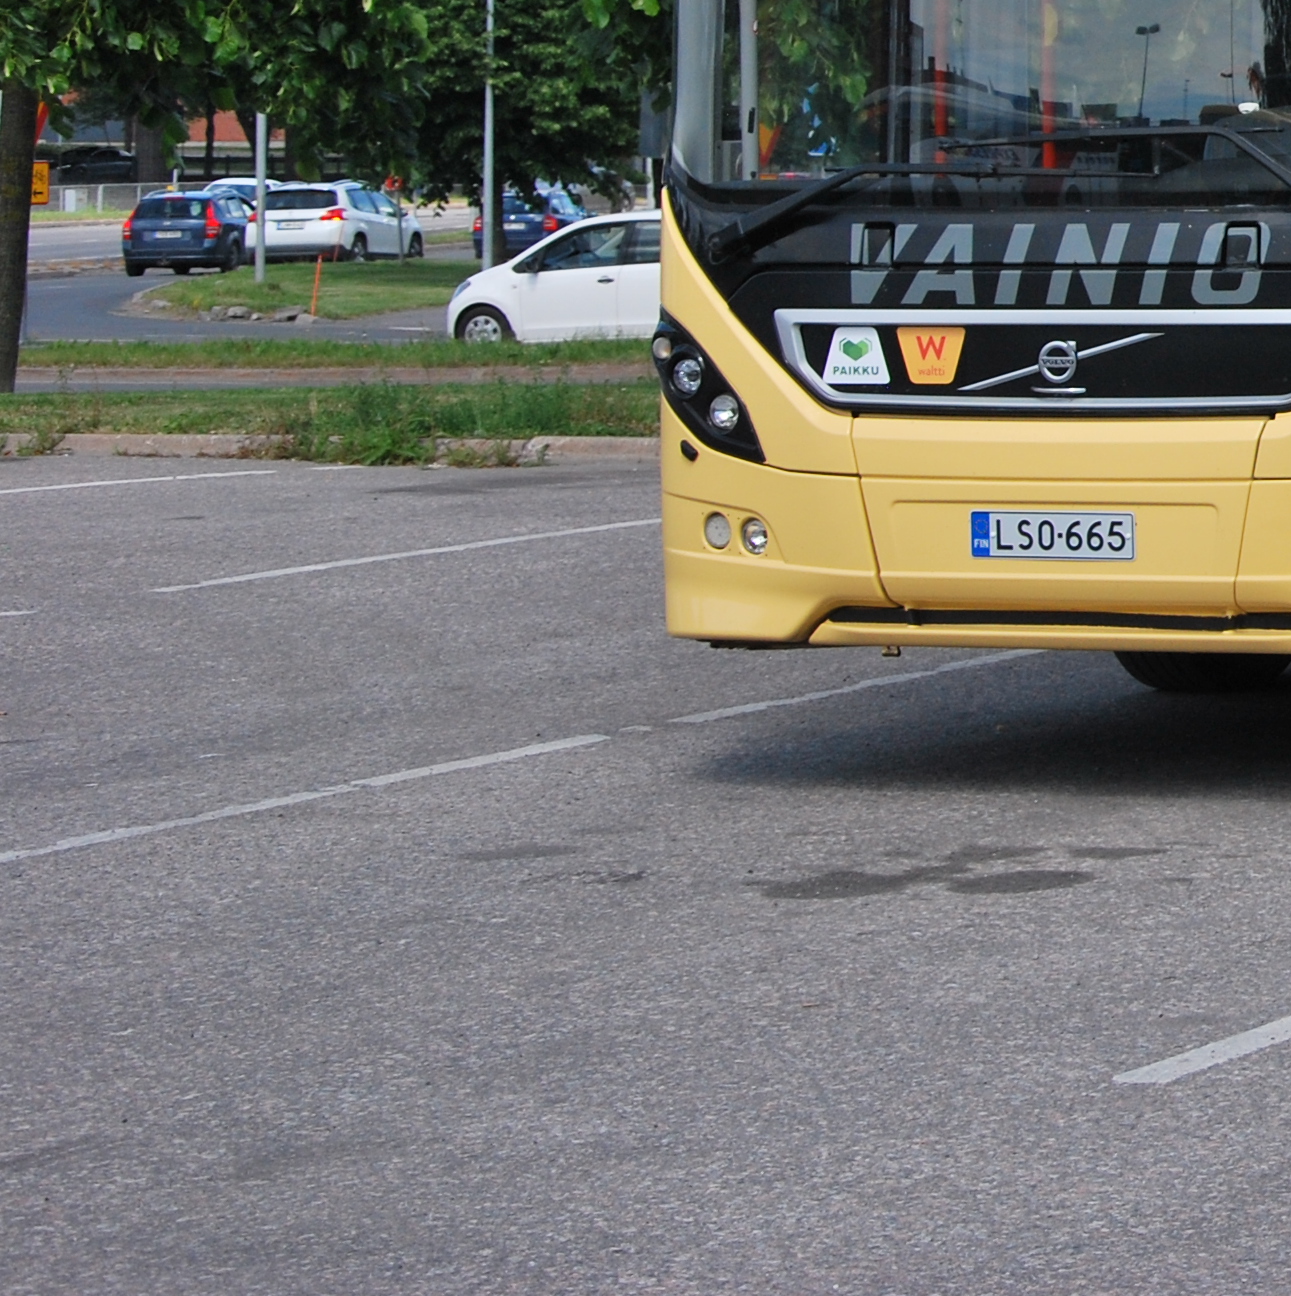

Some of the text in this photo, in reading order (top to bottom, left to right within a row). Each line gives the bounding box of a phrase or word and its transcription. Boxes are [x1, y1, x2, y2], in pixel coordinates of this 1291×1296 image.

[850, 222, 1272, 304] VAINIO
[916, 335, 946, 360] W
[1041, 358, 1076, 367] VOLVO
[833, 365, 880, 376] PAIKKU
[918, 365, 946, 377] waltti
[996, 519, 1126, 552] LSO-665
[973, 538, 989, 549] FIN
